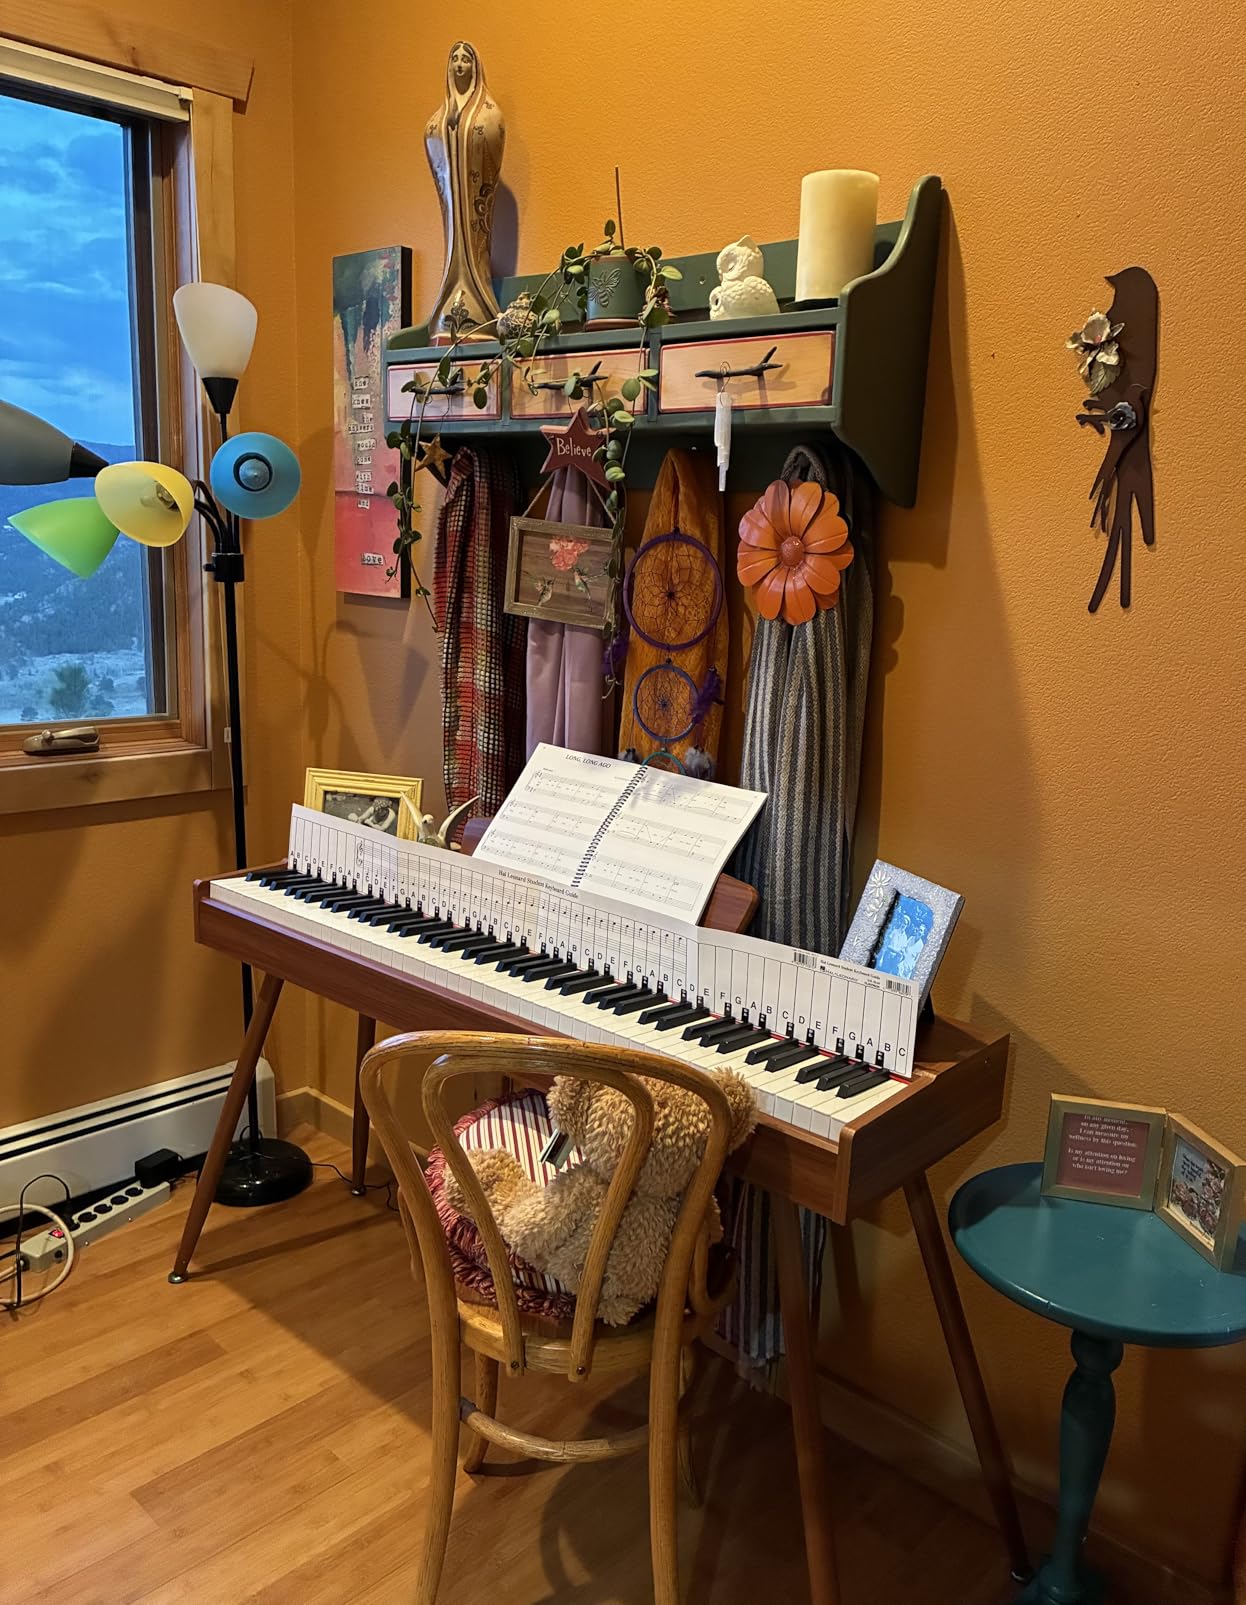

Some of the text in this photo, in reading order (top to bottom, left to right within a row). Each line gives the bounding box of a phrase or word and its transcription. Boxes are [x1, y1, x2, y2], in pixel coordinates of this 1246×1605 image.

[557, 438, 591, 456] Believe
[566, 754, 581, 762] LONG,
[508, 872, 526, 882] Leonard
[527, 877, 544, 887] Student
[545, 883, 564, 894] Keyboard
[565, 890, 578, 898] Guide
[504, 921, 509, 929] C
[527, 928, 532, 937] E
[548, 936, 554, 944] G
[597, 952, 603, 960] D
[610, 956, 615, 965] E
[636, 965, 642, 973] G
[663, 973, 669, 982] B
[676, 978, 682, 987] C
[690, 983, 695, 992] D
[703, 988, 710, 996] E
[720, 991, 726, 1000] F
[735, 996, 742, 1005] G
[750, 1001, 757, 1010] A
[766, 1005, 772, 1014] B
[782, 1010, 789, 1020] C
[798, 1015, 805, 1024] D
[815, 1020, 821, 1030] E
[832, 1026, 838, 1034] F
[848, 1031, 856, 1041] G
[866, 1038, 873, 1046] A
[884, 1042, 891, 1052] B
[898, 1047, 906, 1057] C
